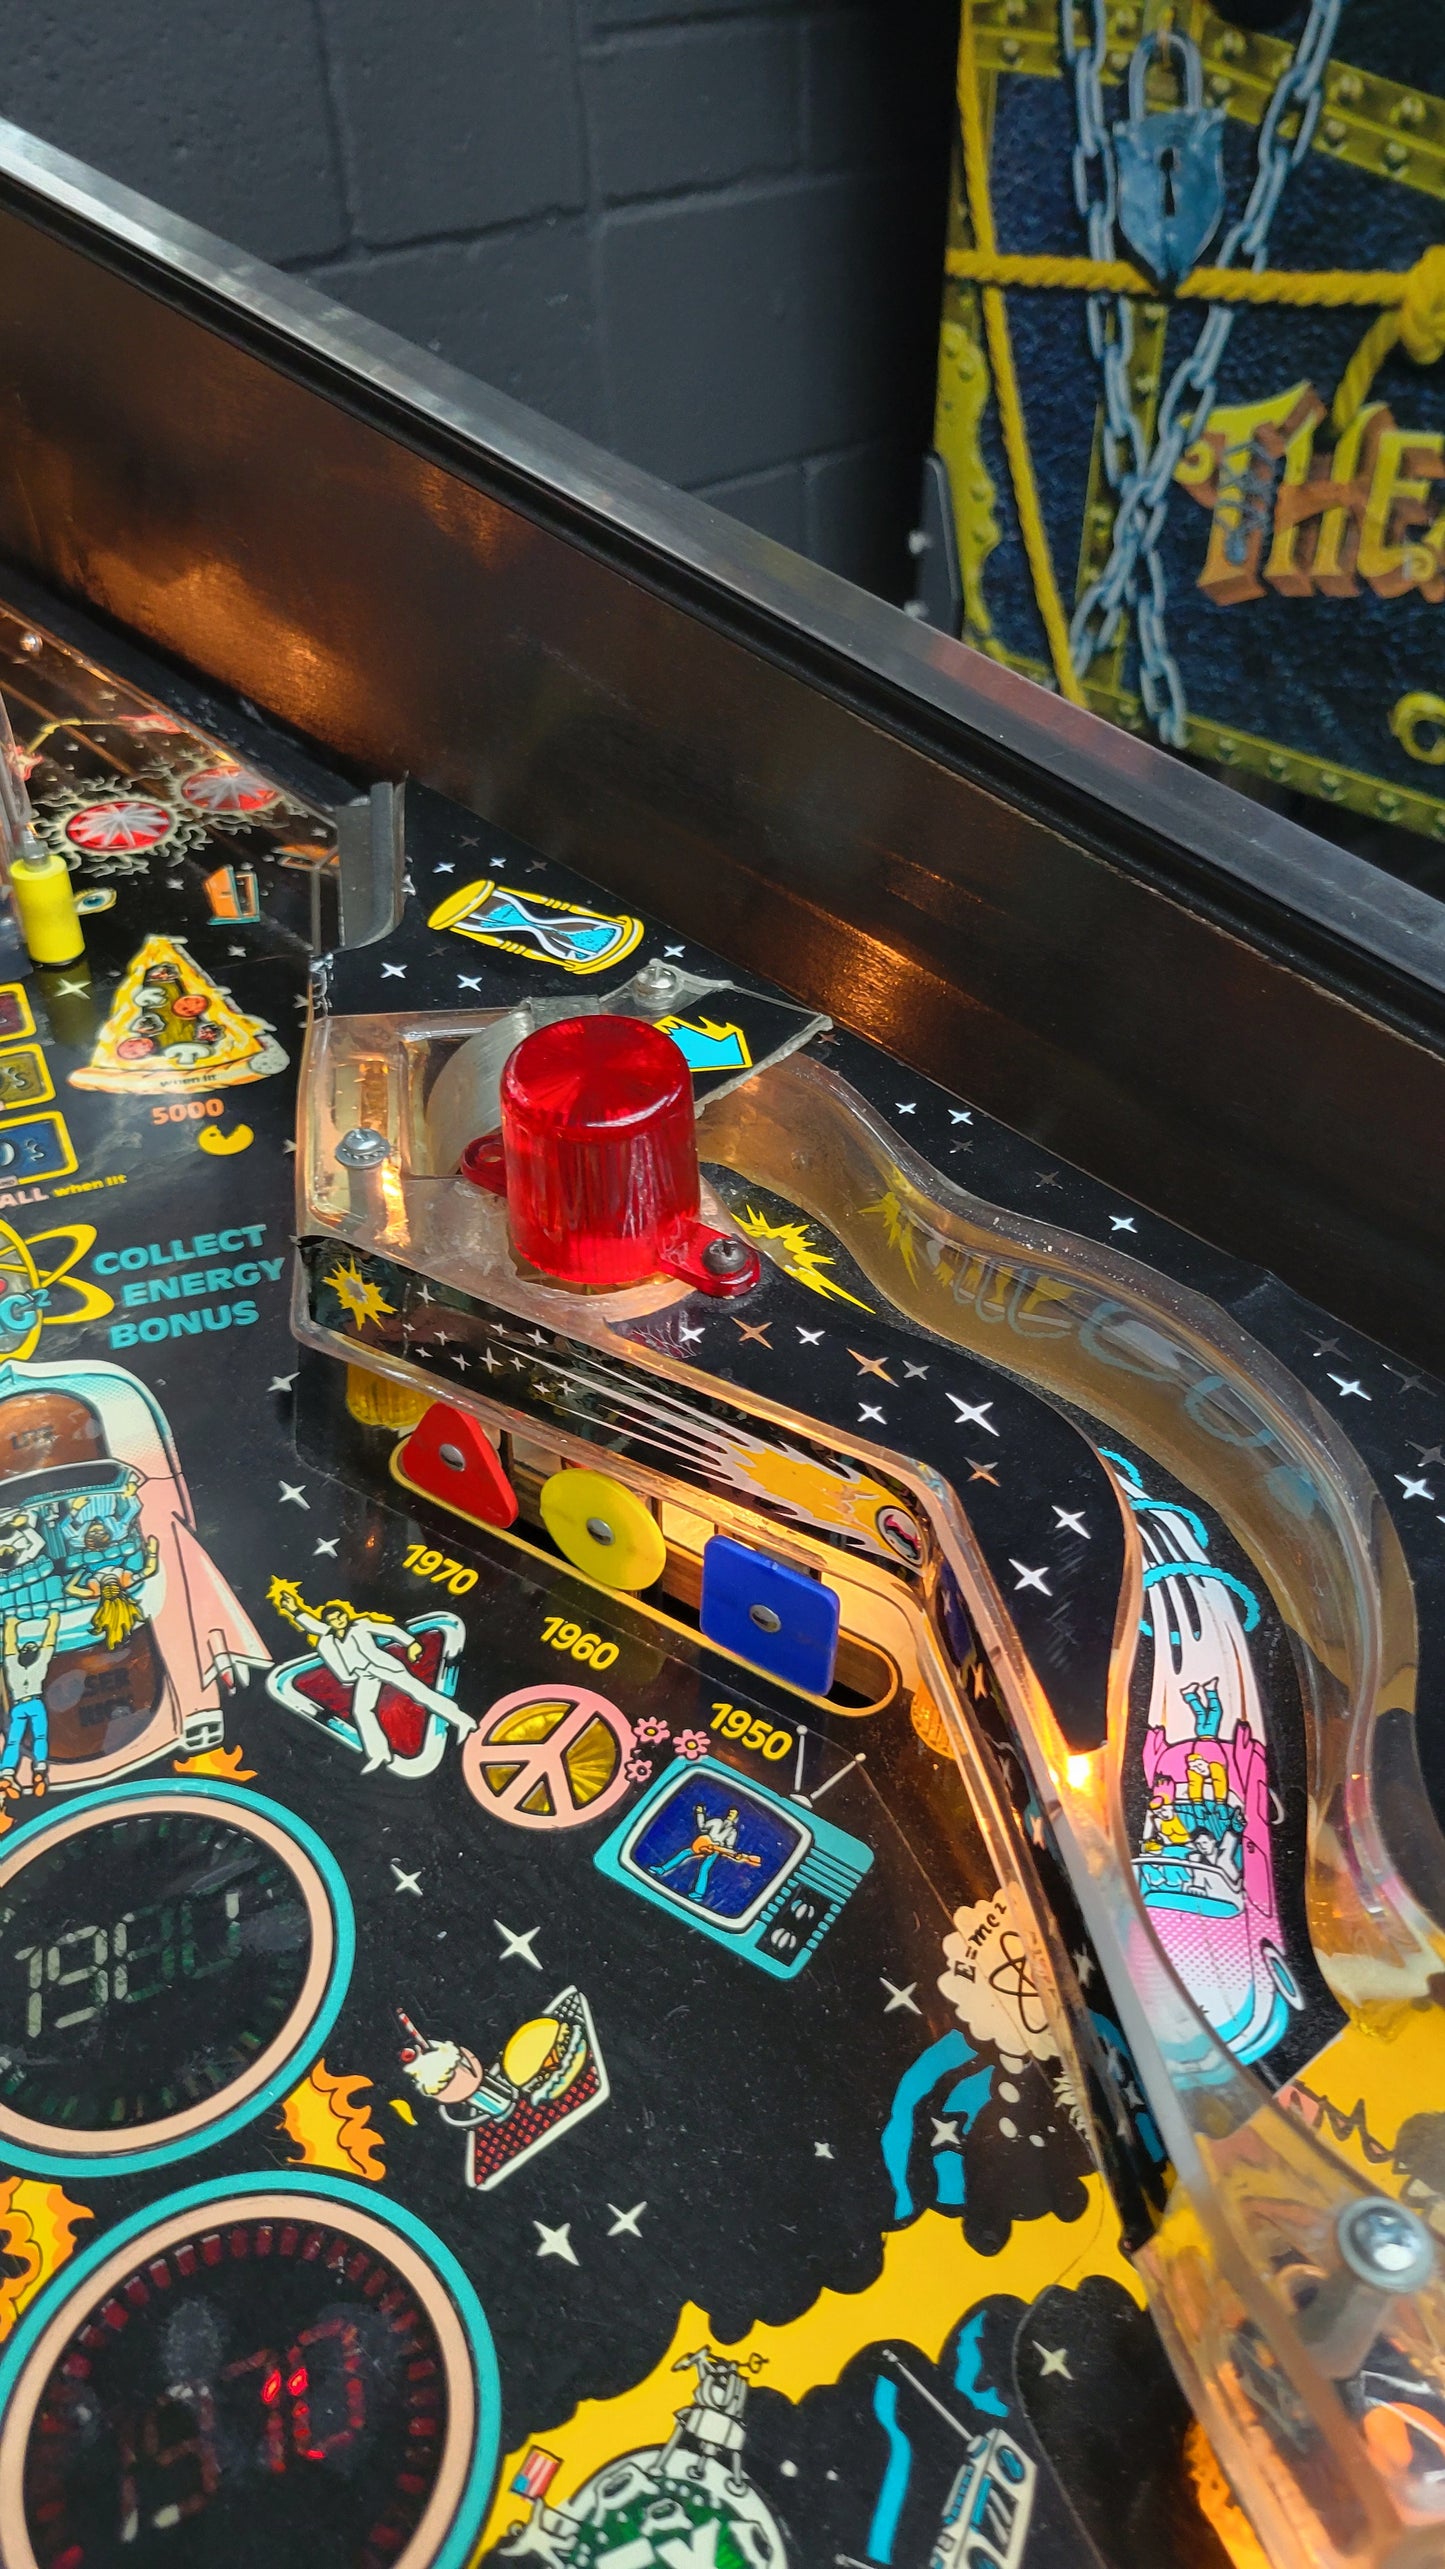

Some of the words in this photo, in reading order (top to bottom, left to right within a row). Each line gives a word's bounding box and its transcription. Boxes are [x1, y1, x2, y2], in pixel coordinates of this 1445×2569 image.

[152, 1098, 225, 1126] 5000
[53, 1178, 104, 1197] when
[105, 1172, 128, 1186] lit
[92, 1224, 268, 1275] COLLECT
[121, 1257, 286, 1308] ENERGY
[108, 1300, 260, 1349] BONUS
[402, 1544, 479, 1595] 1970
[539, 1616, 620, 1671] 1960
[710, 1702, 793, 1761] 1950
